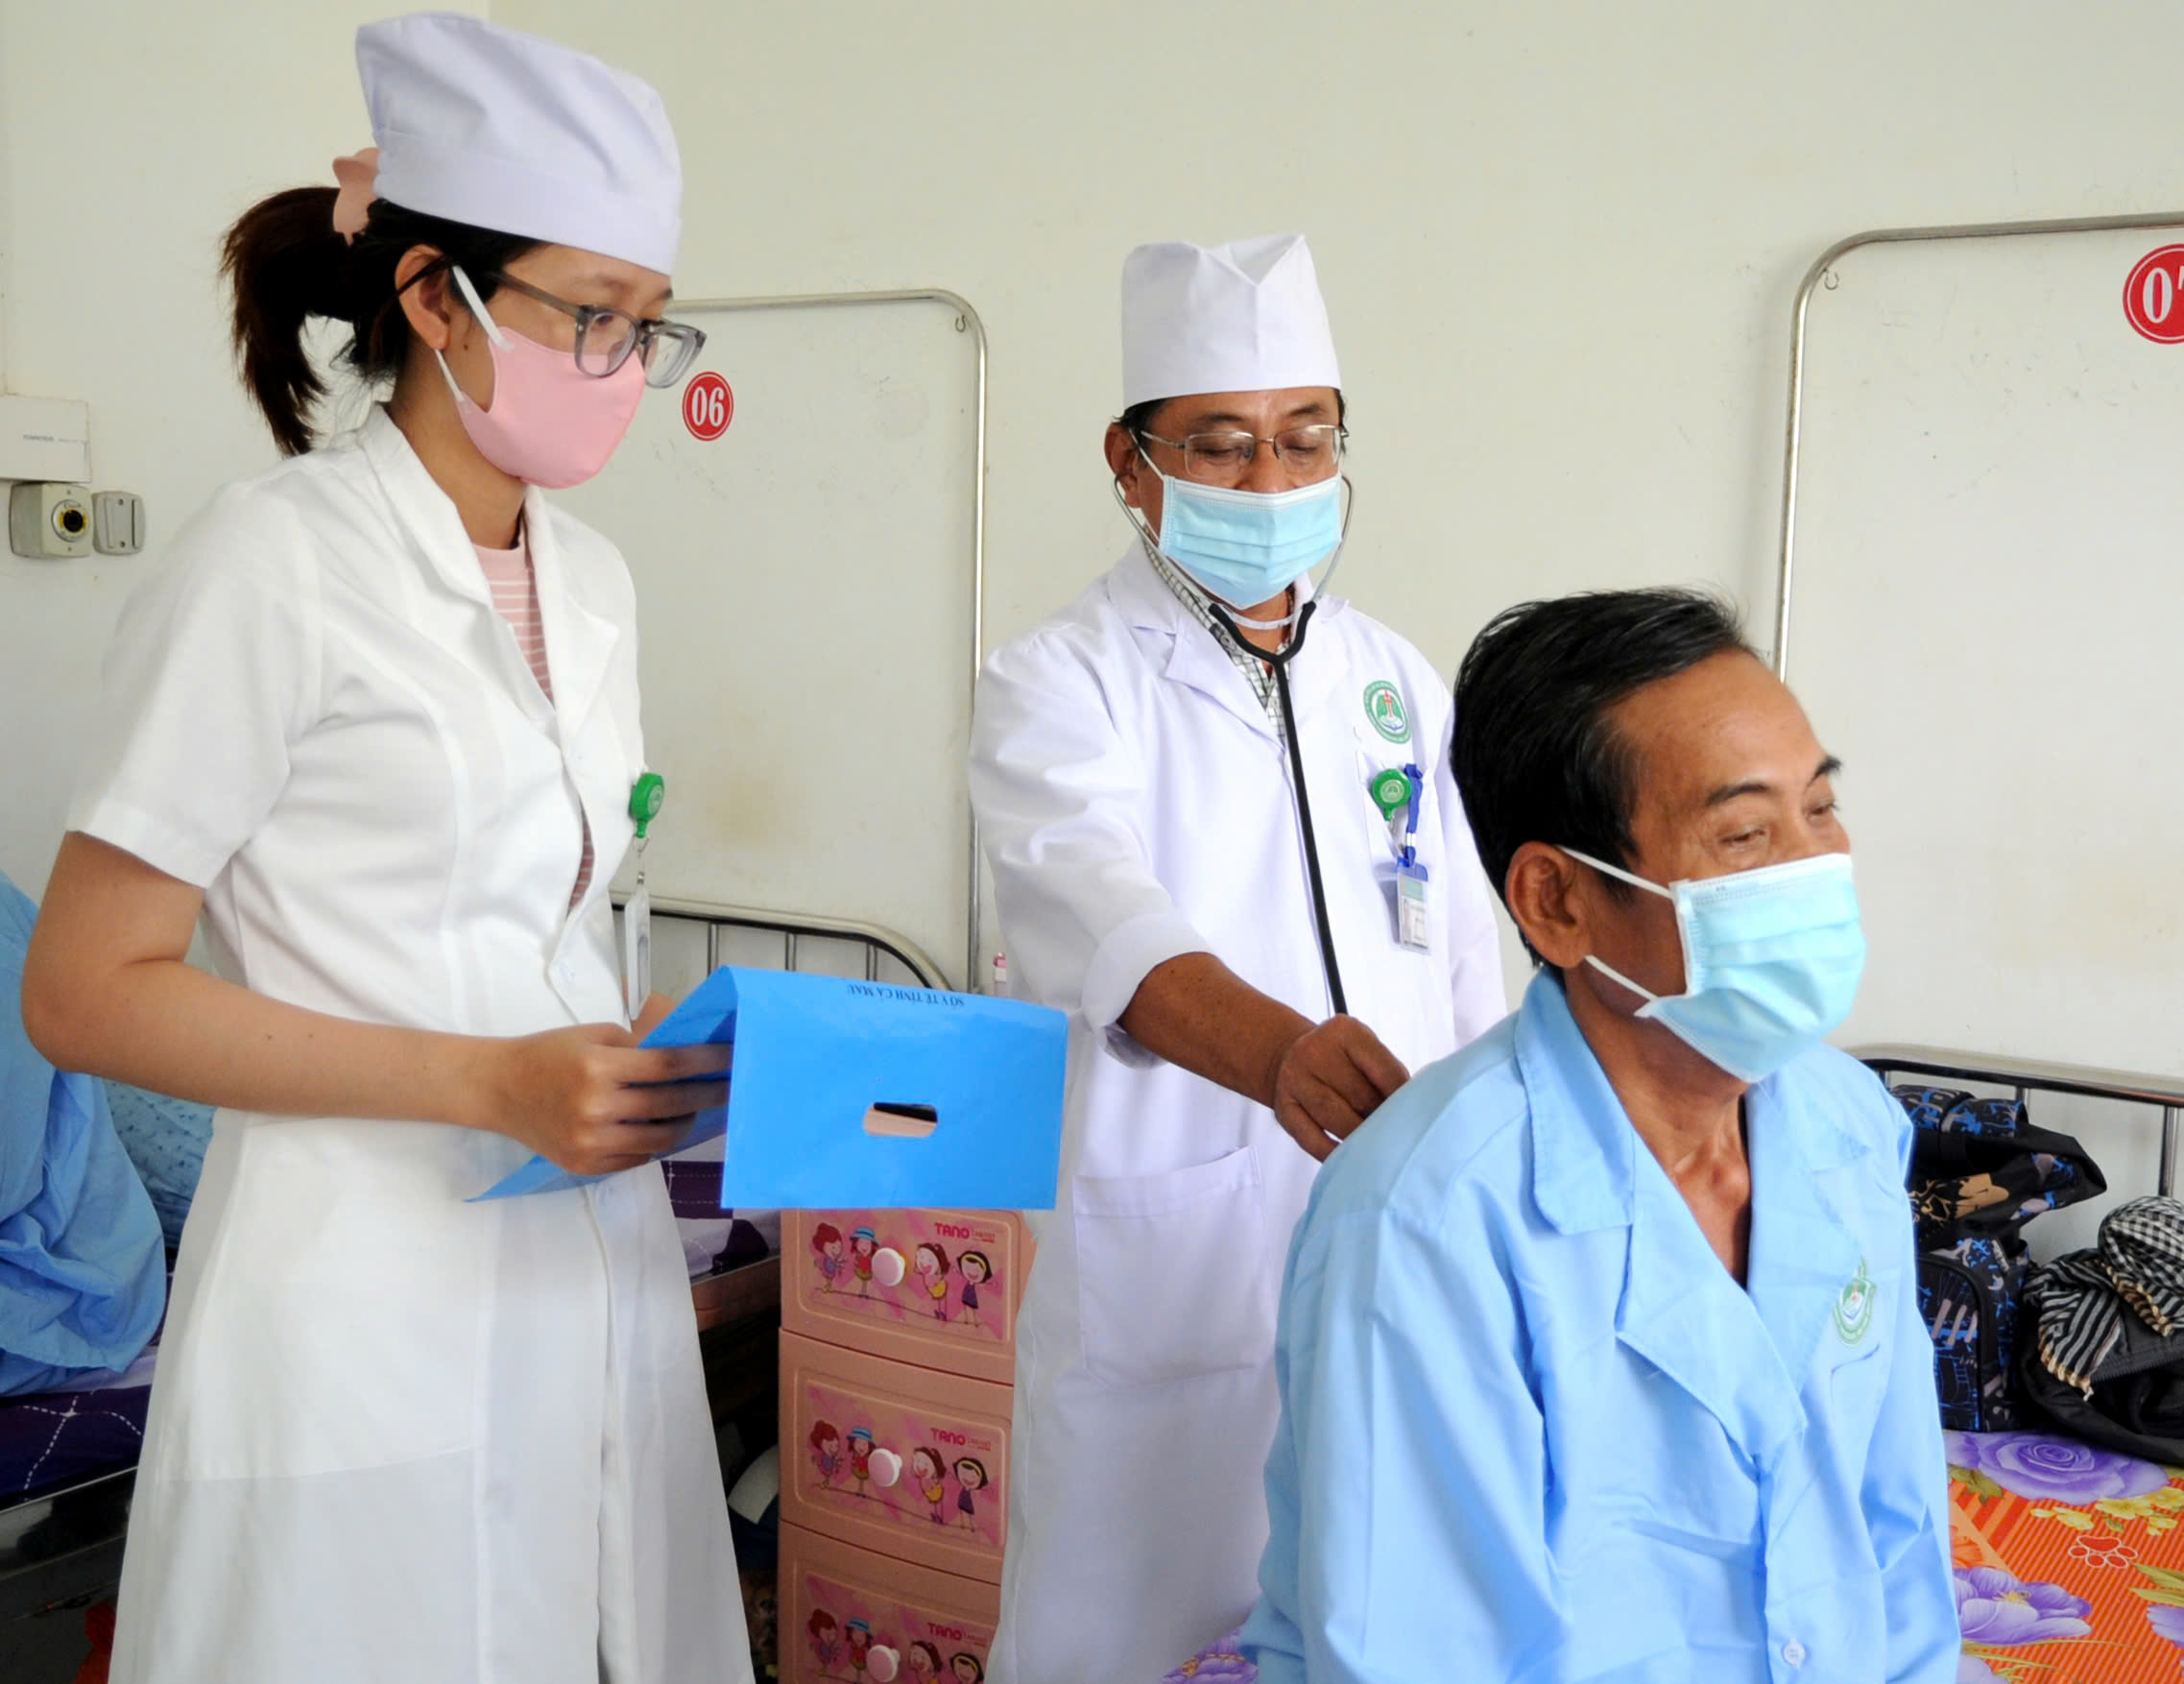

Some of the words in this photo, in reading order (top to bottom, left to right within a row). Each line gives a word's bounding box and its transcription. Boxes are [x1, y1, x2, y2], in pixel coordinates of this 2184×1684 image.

[2143, 265, 2184, 324] 0
[691, 386, 725, 427] 06
[934, 1222, 971, 1239] TANO
[930, 1428, 967, 1446] TANO
[926, 1622, 962, 1641] TANO
